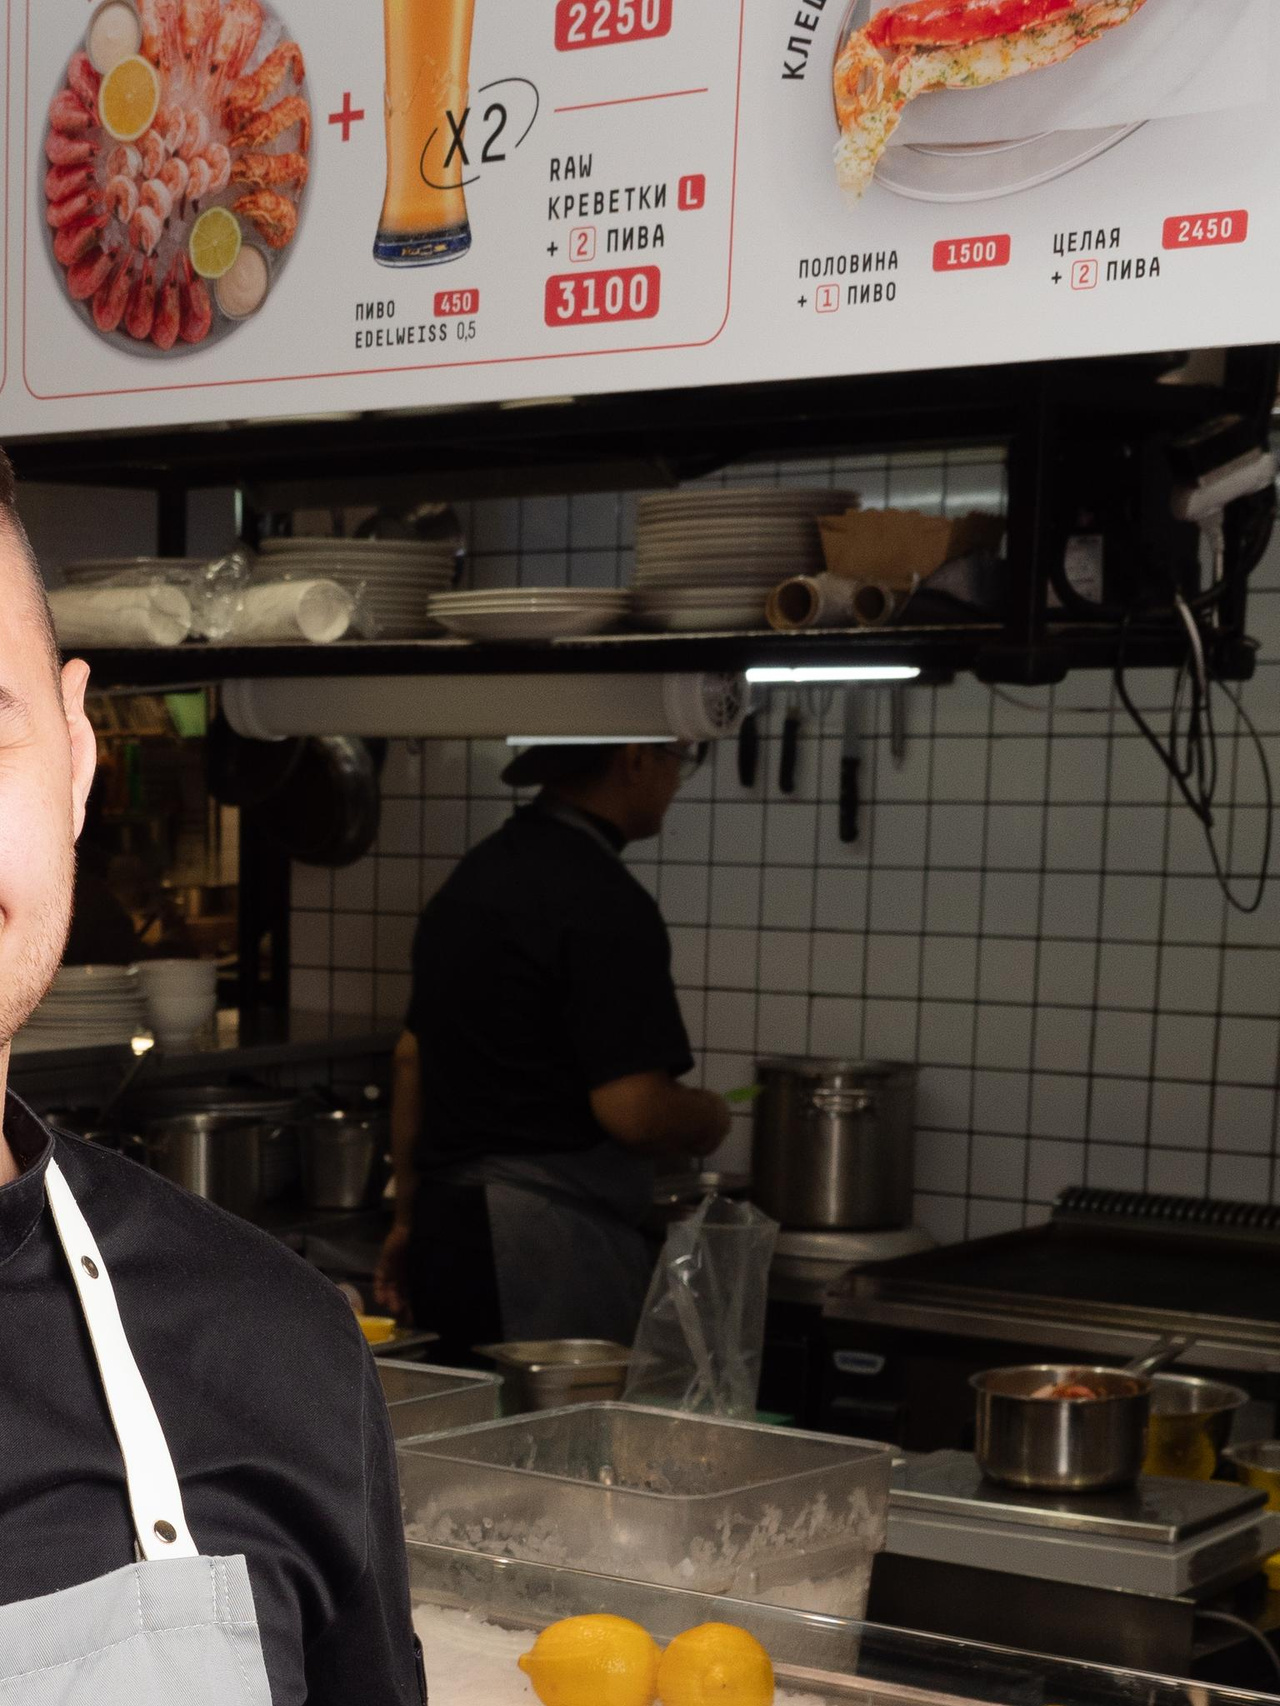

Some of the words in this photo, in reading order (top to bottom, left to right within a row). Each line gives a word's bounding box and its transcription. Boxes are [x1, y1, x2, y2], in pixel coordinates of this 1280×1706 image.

[567, 0, 660, 43] 2250
[550, 153, 592, 182] RAW
[548, 183, 667, 221] КРЕВЕТКИ
[607, 224, 665, 253] ПИВА
[1053, 227, 1121, 257] ЦЕЛАЯ
[1177, 216, 1233, 243] 2450
[799, 250, 899, 279] ПОЛОВИНА
[946, 240, 997, 265] 1500
[1106, 256, 1161, 282] ПИВА
[355, 300, 395, 321] ПИВО
[440, 291, 472, 314] 450
[556, 273, 649, 320] 3100
[847, 281, 897, 305] ПИВО
[355, 323, 447, 349] EDELWEISS
[456, 320, 476, 343] 0,5
